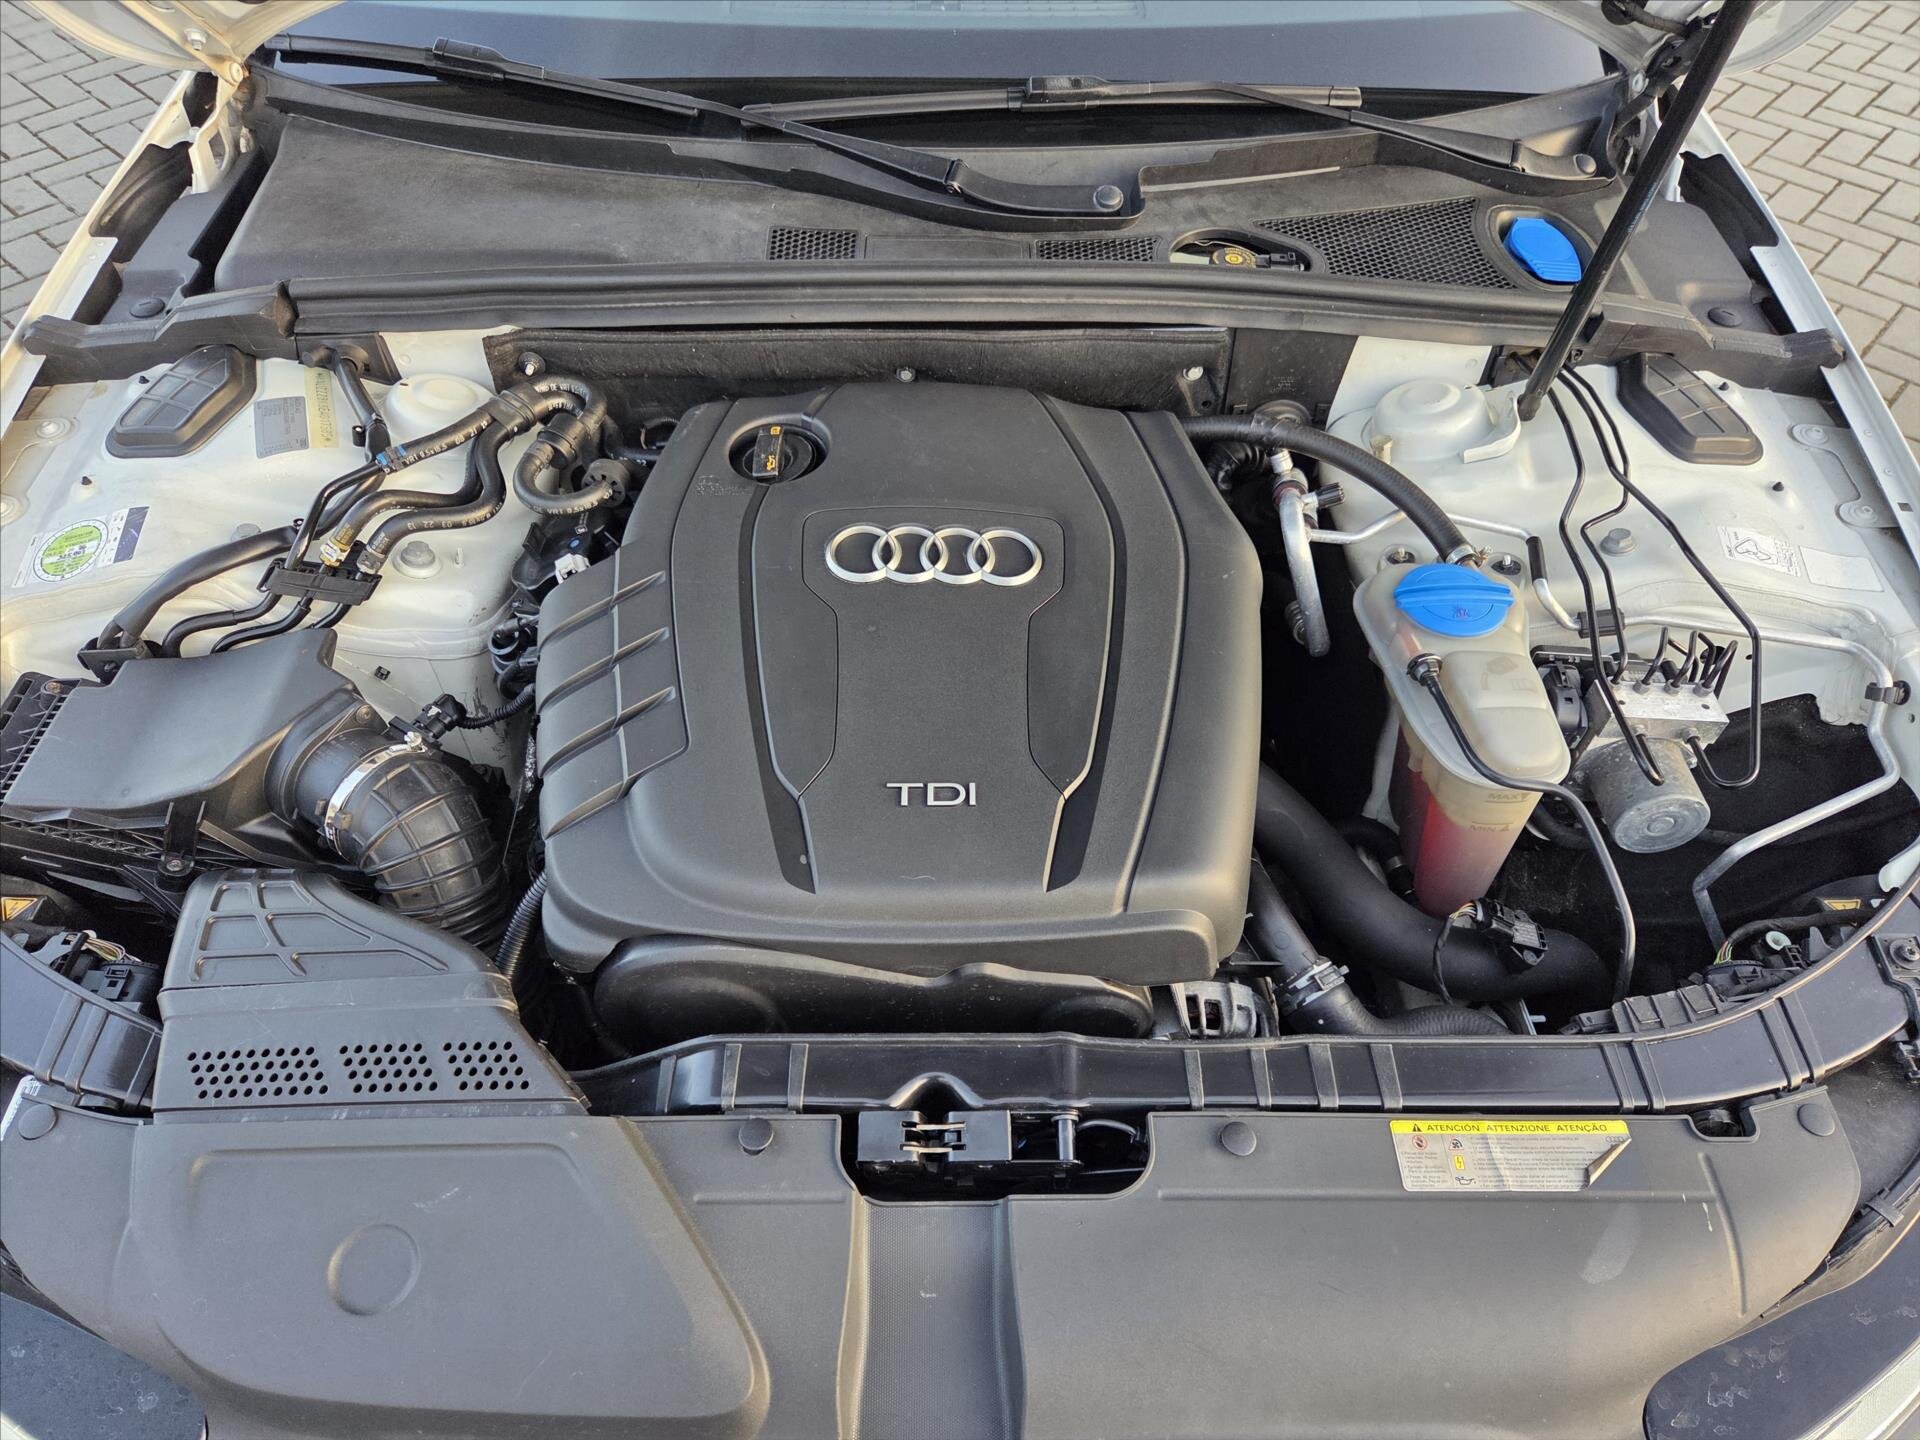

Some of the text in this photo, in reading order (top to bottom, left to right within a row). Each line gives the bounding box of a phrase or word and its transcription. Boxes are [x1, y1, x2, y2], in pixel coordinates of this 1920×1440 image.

[886, 782, 977, 807] TDI
[1489, 792, 1519, 800] MAX
[1427, 1122, 1608, 1133] ATENCIÓN ATTENZIONE ATENÇÃO
